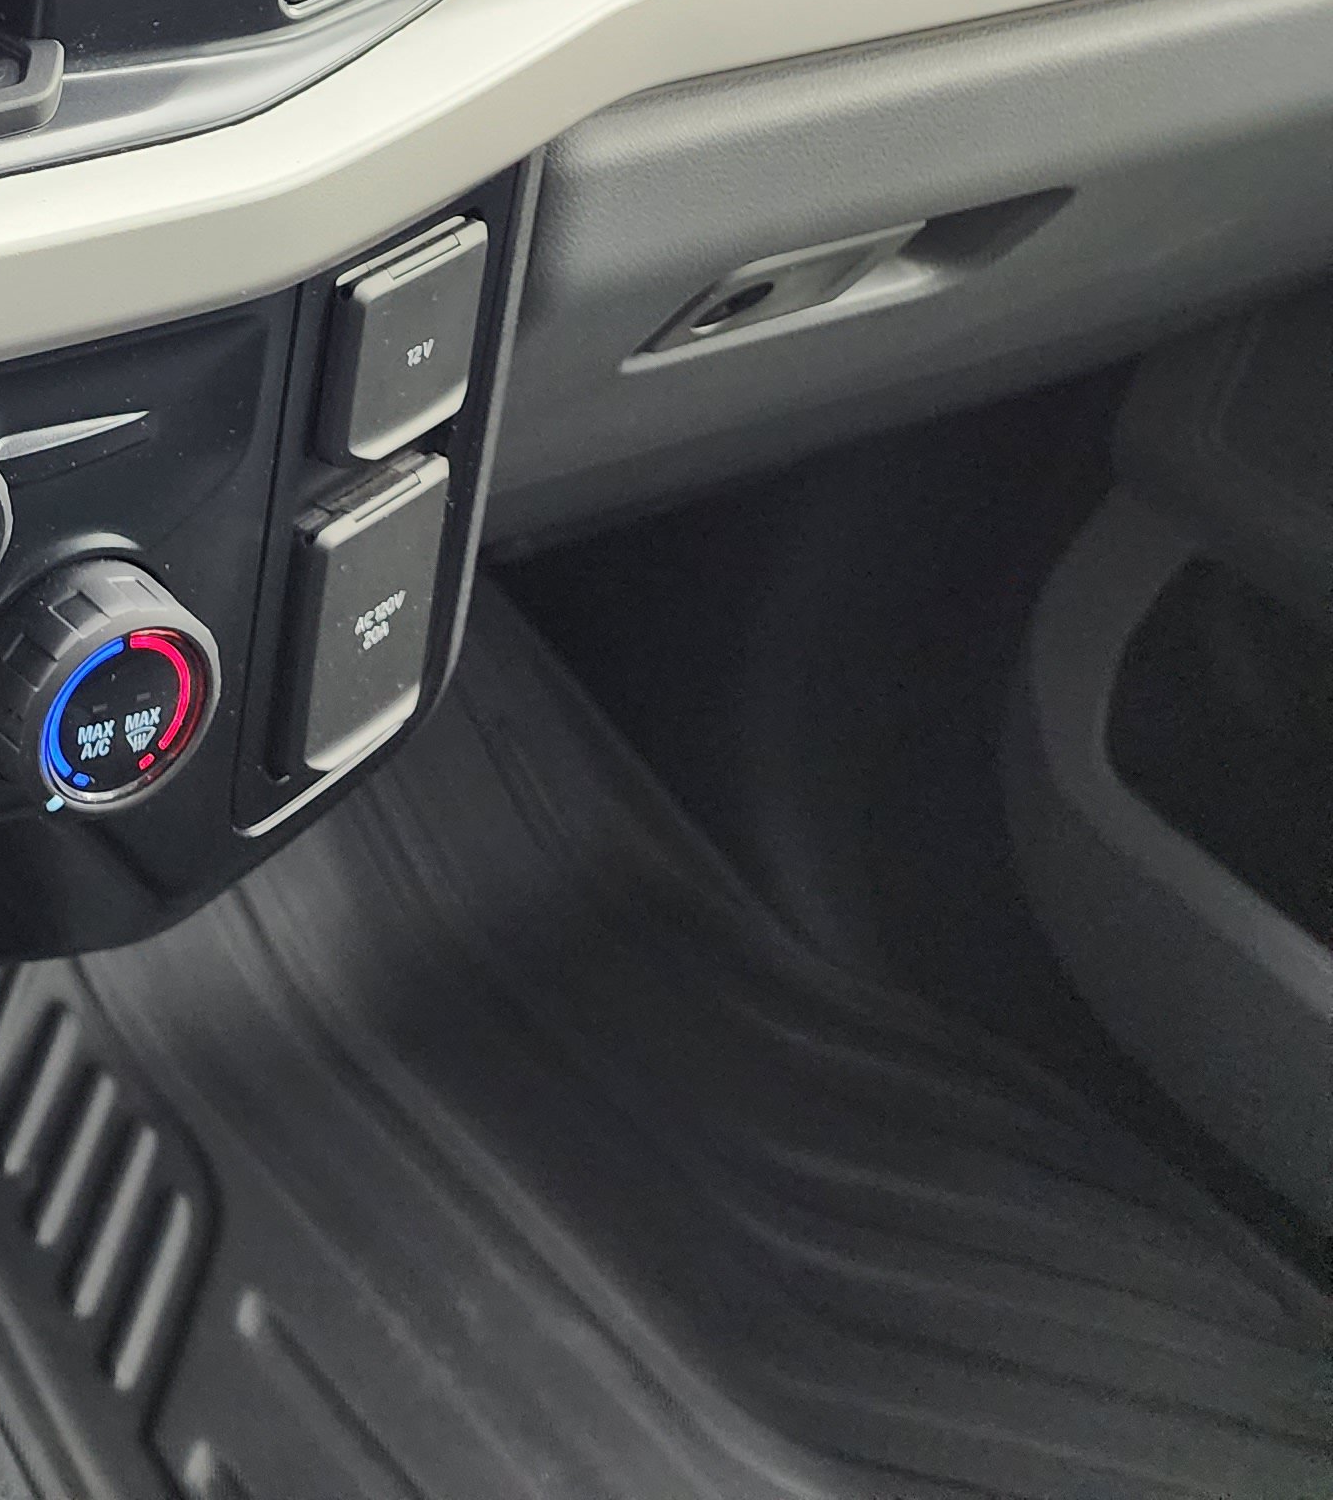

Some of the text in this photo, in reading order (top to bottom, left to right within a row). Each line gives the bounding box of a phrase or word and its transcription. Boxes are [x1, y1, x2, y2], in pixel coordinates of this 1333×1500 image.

[77, 719, 116, 746] MAX
[124, 706, 162, 733] MAX
[80, 737, 111, 761] A/C
